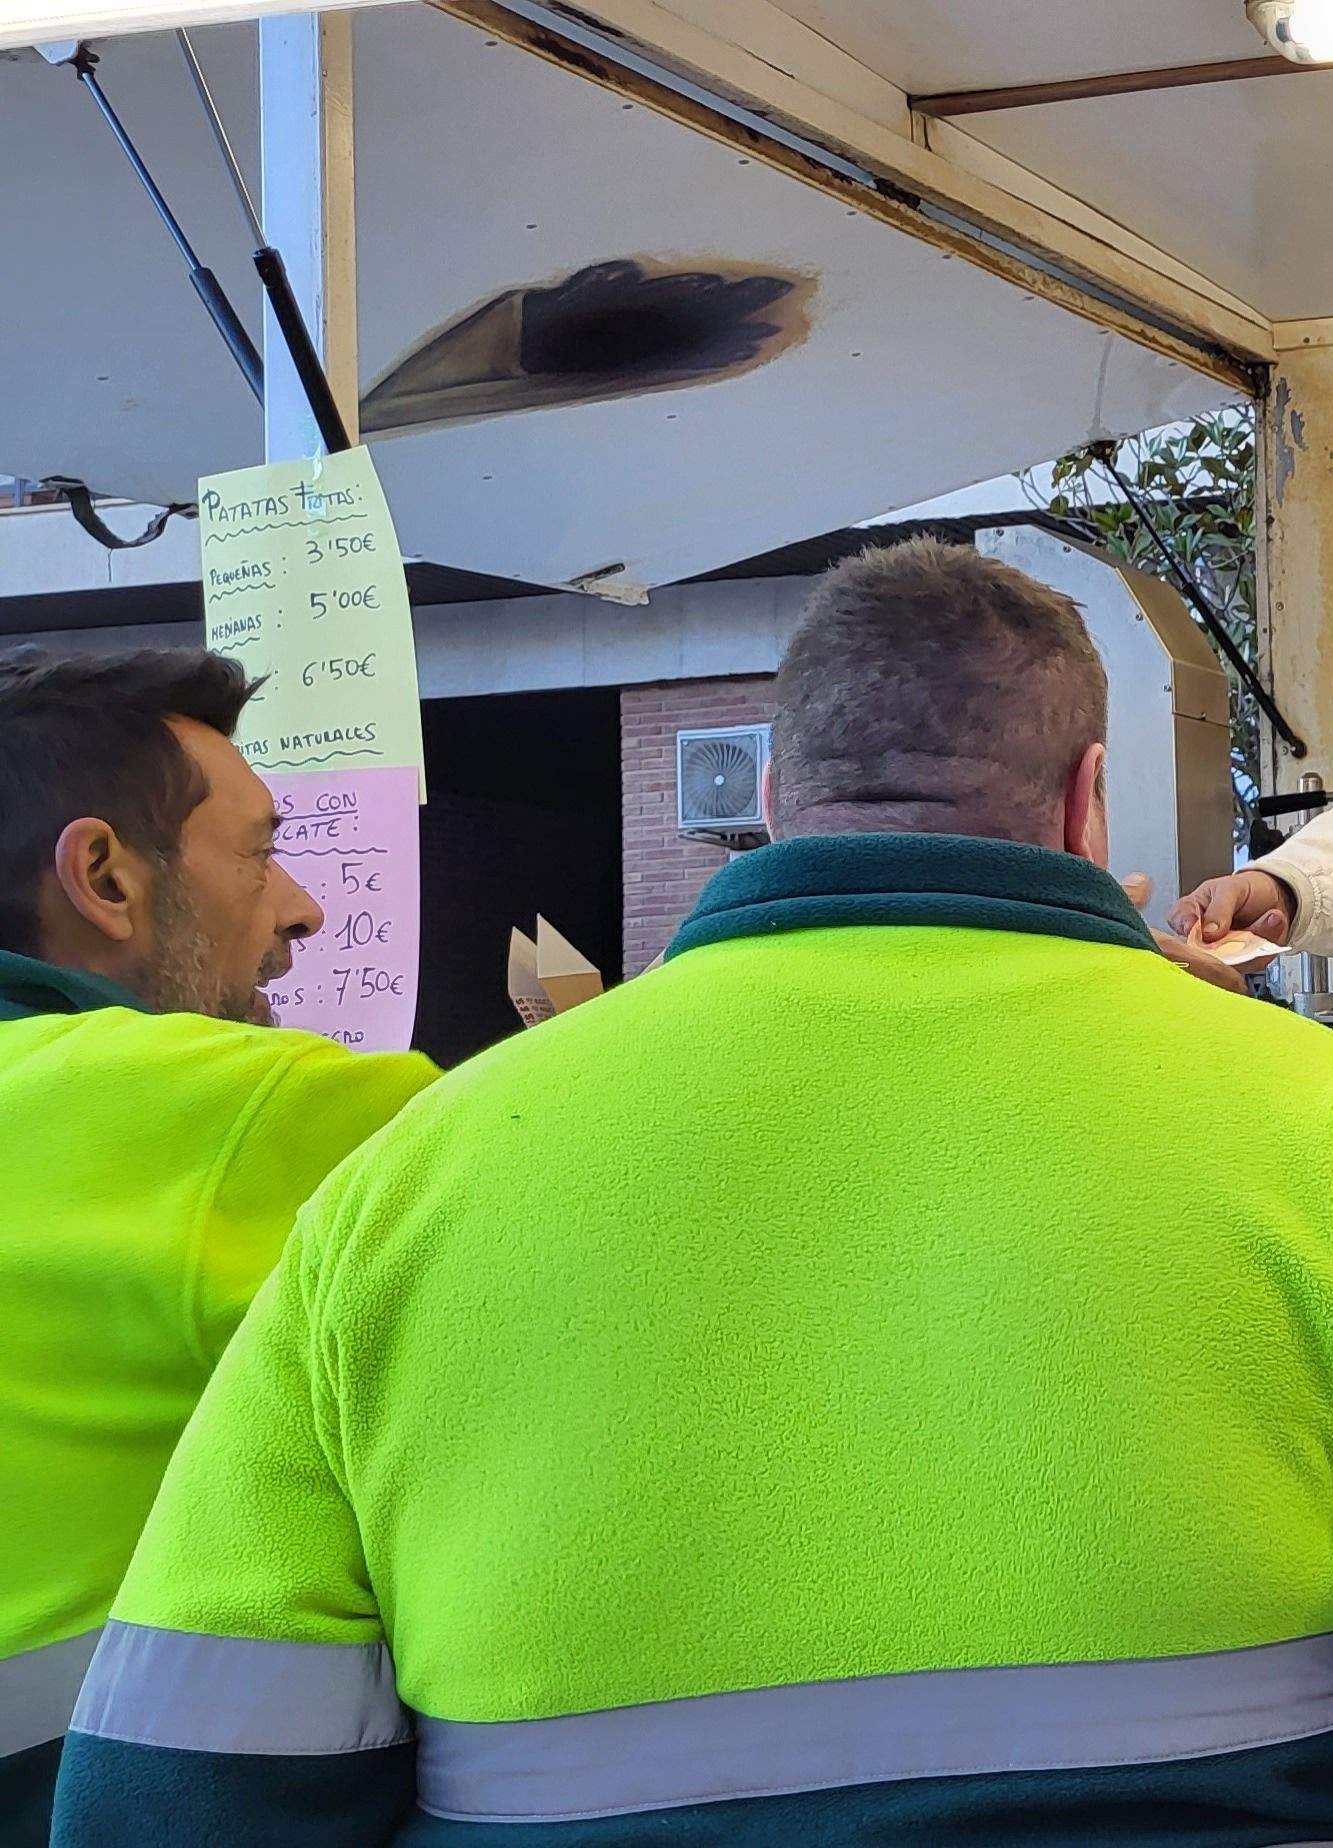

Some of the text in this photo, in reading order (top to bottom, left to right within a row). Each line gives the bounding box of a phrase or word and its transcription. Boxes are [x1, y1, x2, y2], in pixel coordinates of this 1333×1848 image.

[202, 488, 289, 522] PATATAS
[280, 722, 377, 751] NATURALES
[316, 791, 357, 812] CON
[334, 911, 392, 951] 10€
[332, 967, 404, 1006] 7'50€
